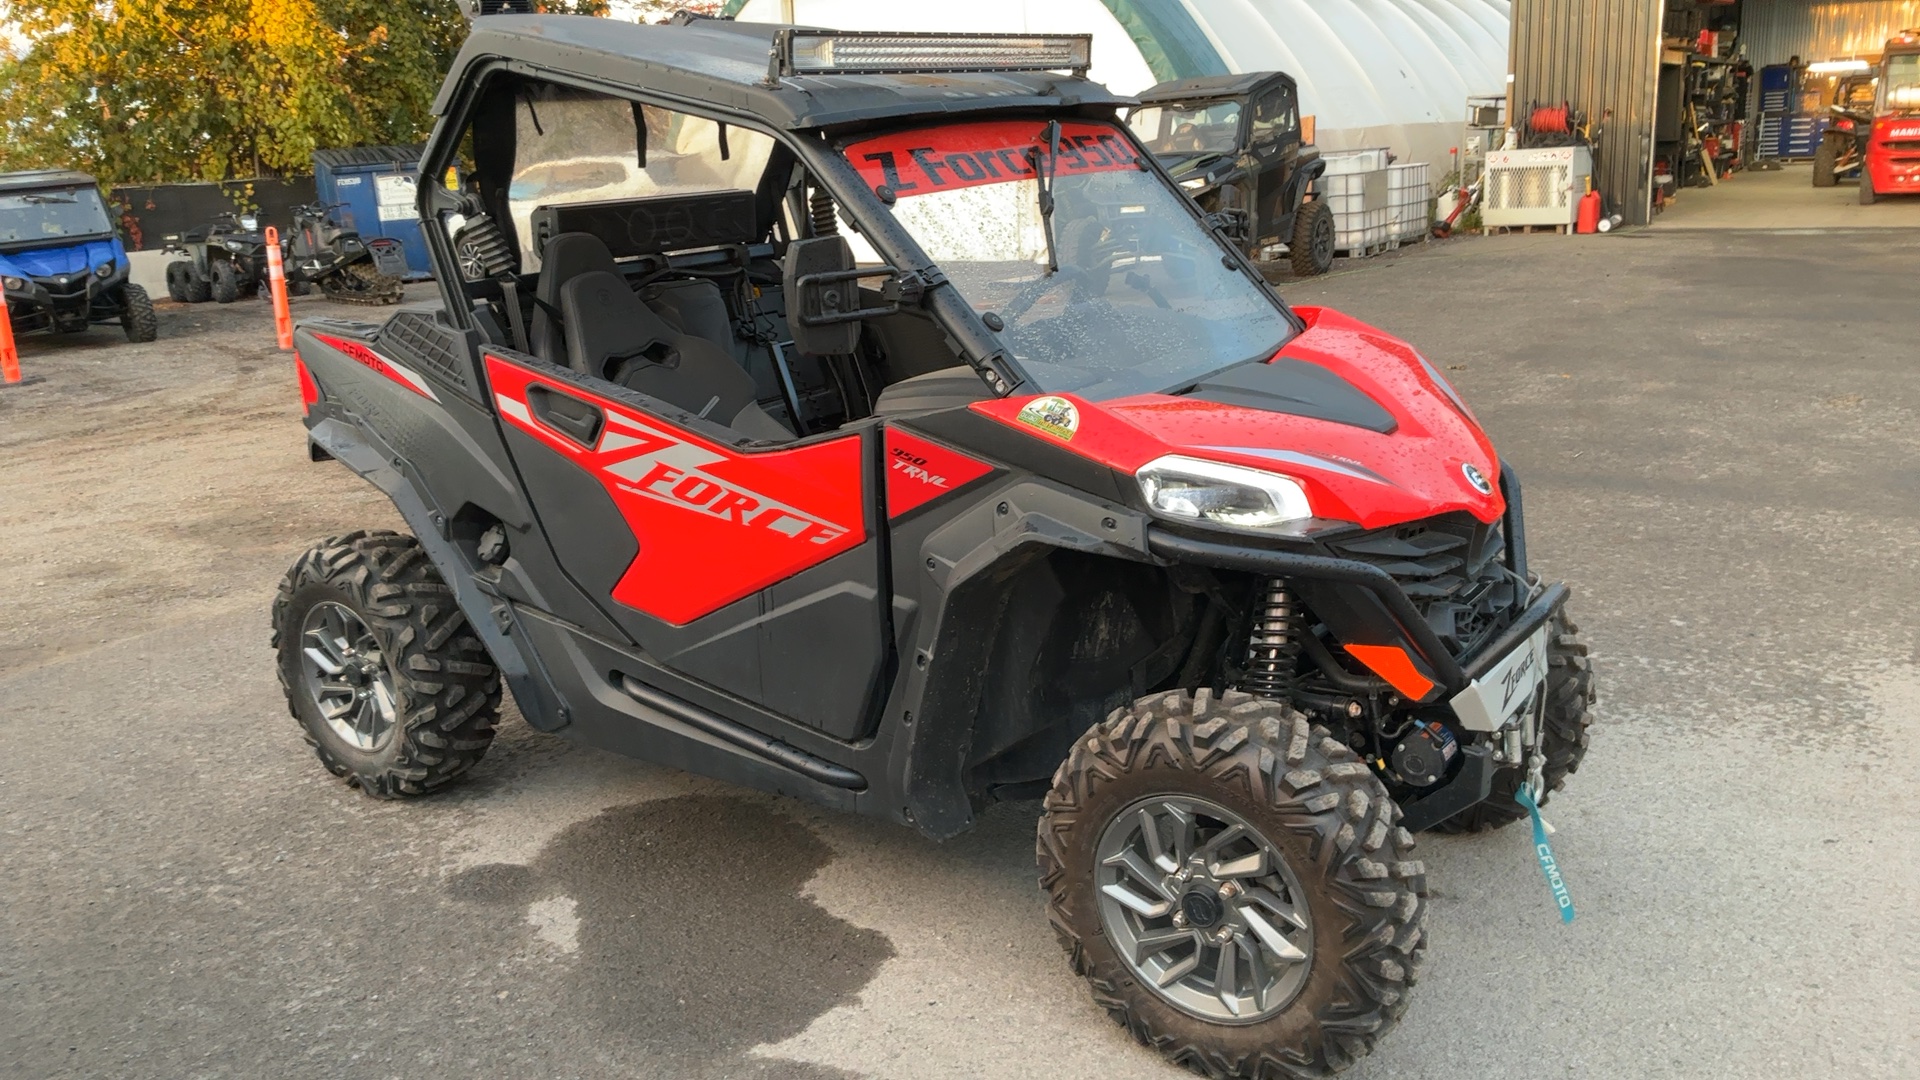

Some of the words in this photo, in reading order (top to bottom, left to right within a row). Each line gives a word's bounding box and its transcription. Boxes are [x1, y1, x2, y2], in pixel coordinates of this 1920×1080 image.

[864, 150, 916, 194] Z
[342, 342, 384, 373] CFMOTO
[890, 447, 928, 467] 950
[892, 458, 950, 489] TRAIL
[1536, 843, 1571, 909] CFMOTO
